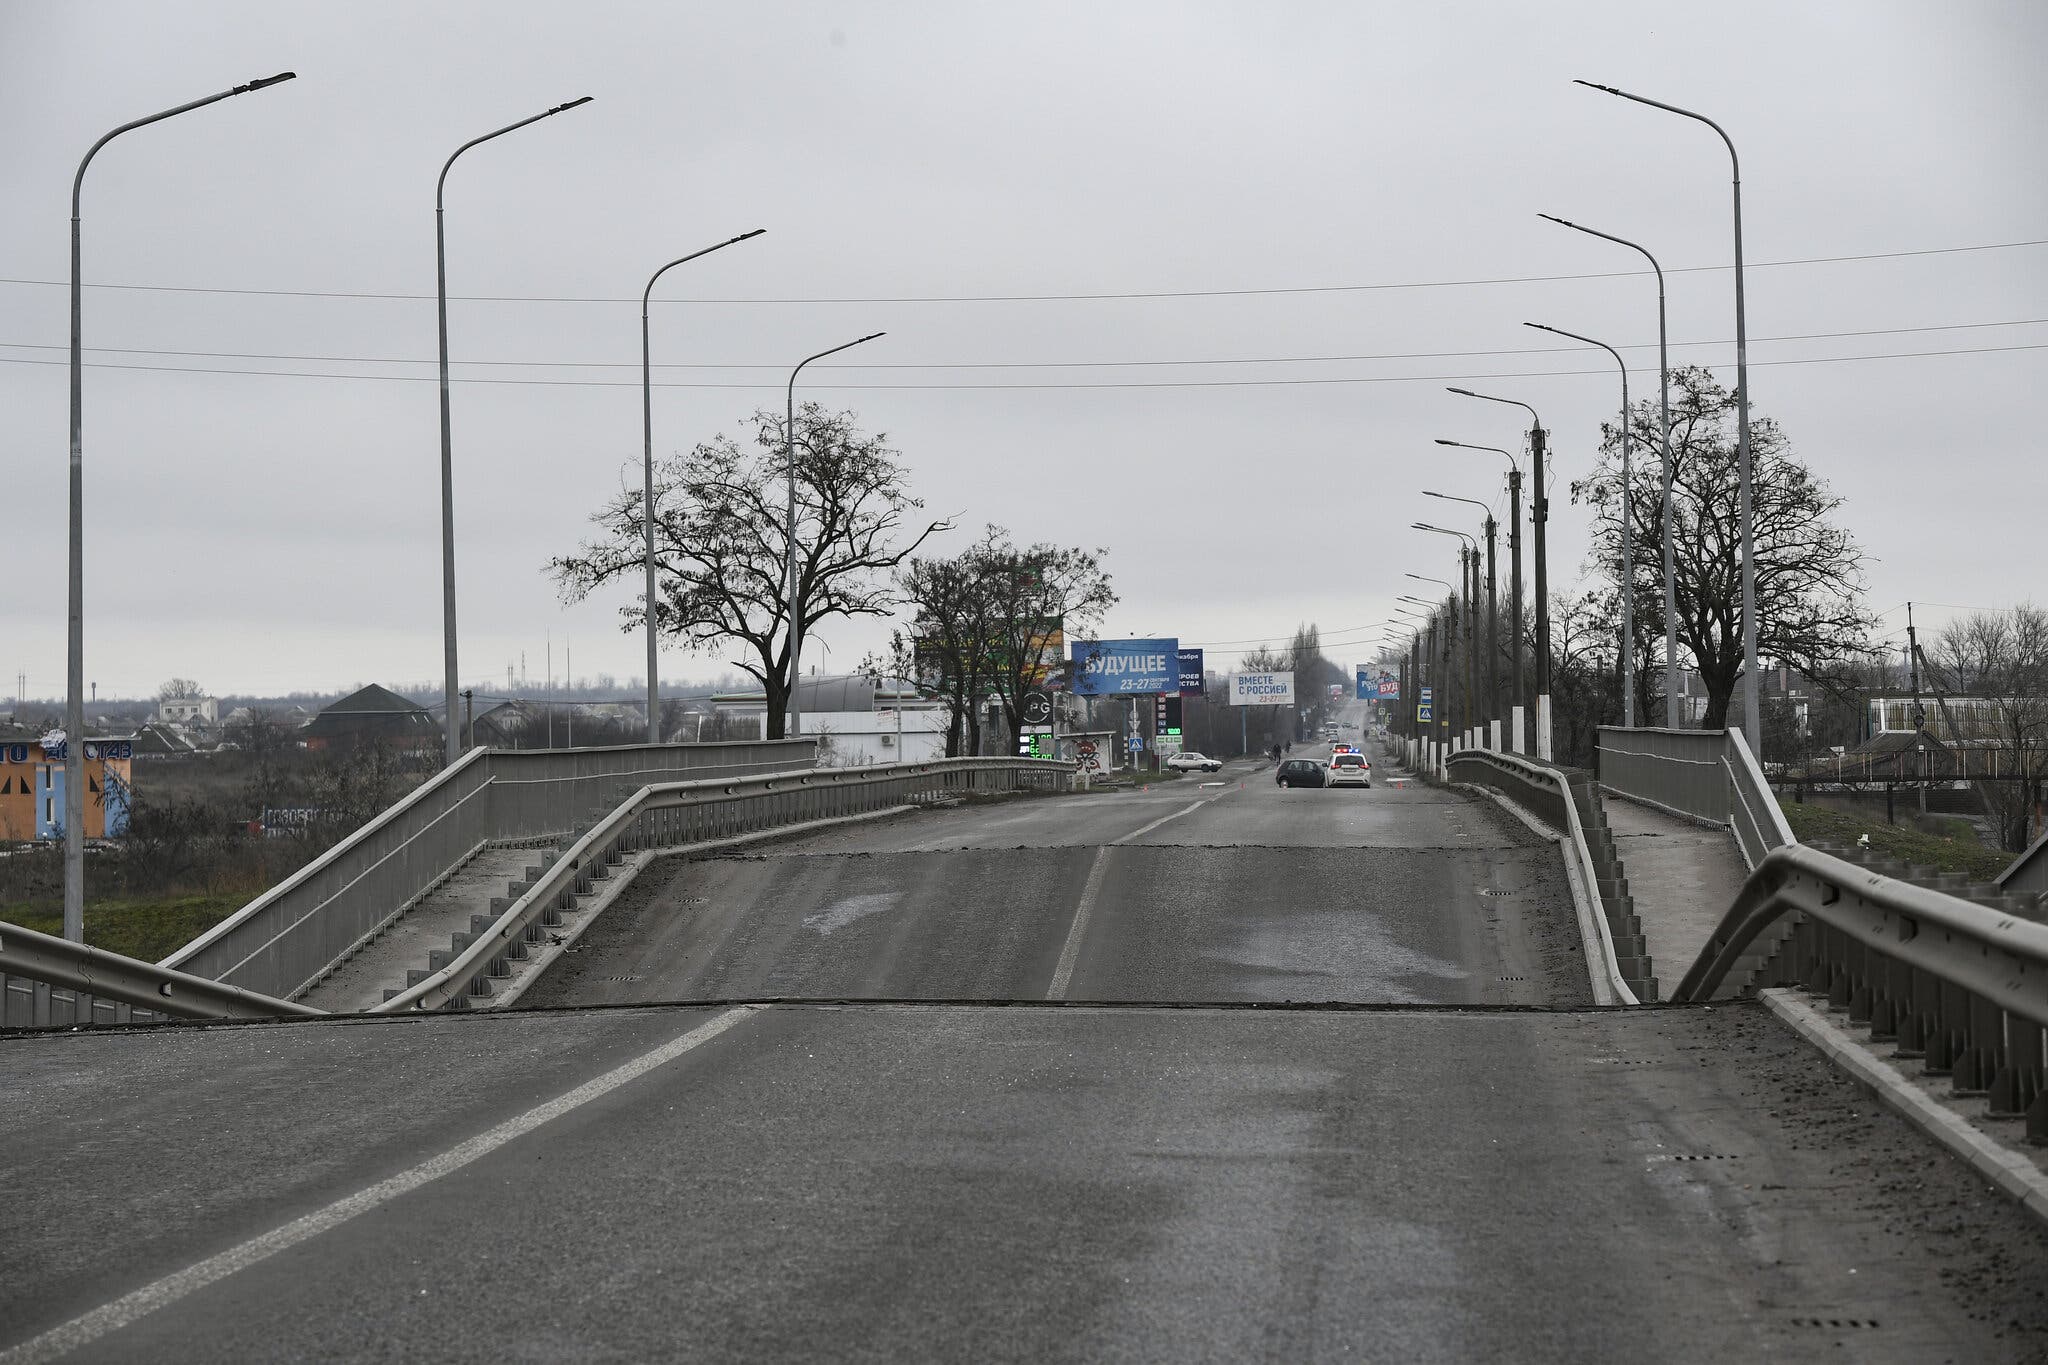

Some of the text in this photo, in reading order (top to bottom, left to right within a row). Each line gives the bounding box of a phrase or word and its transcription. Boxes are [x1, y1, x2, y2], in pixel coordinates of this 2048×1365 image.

[1085, 655, 1167, 675] БУДУЩЕЕ
[1239, 676, 1273, 685] ВМЕСТЕ
[1239, 683, 1287, 695] С РОССИЕЙ
[46, 741, 132, 760] АВОГАЗ
